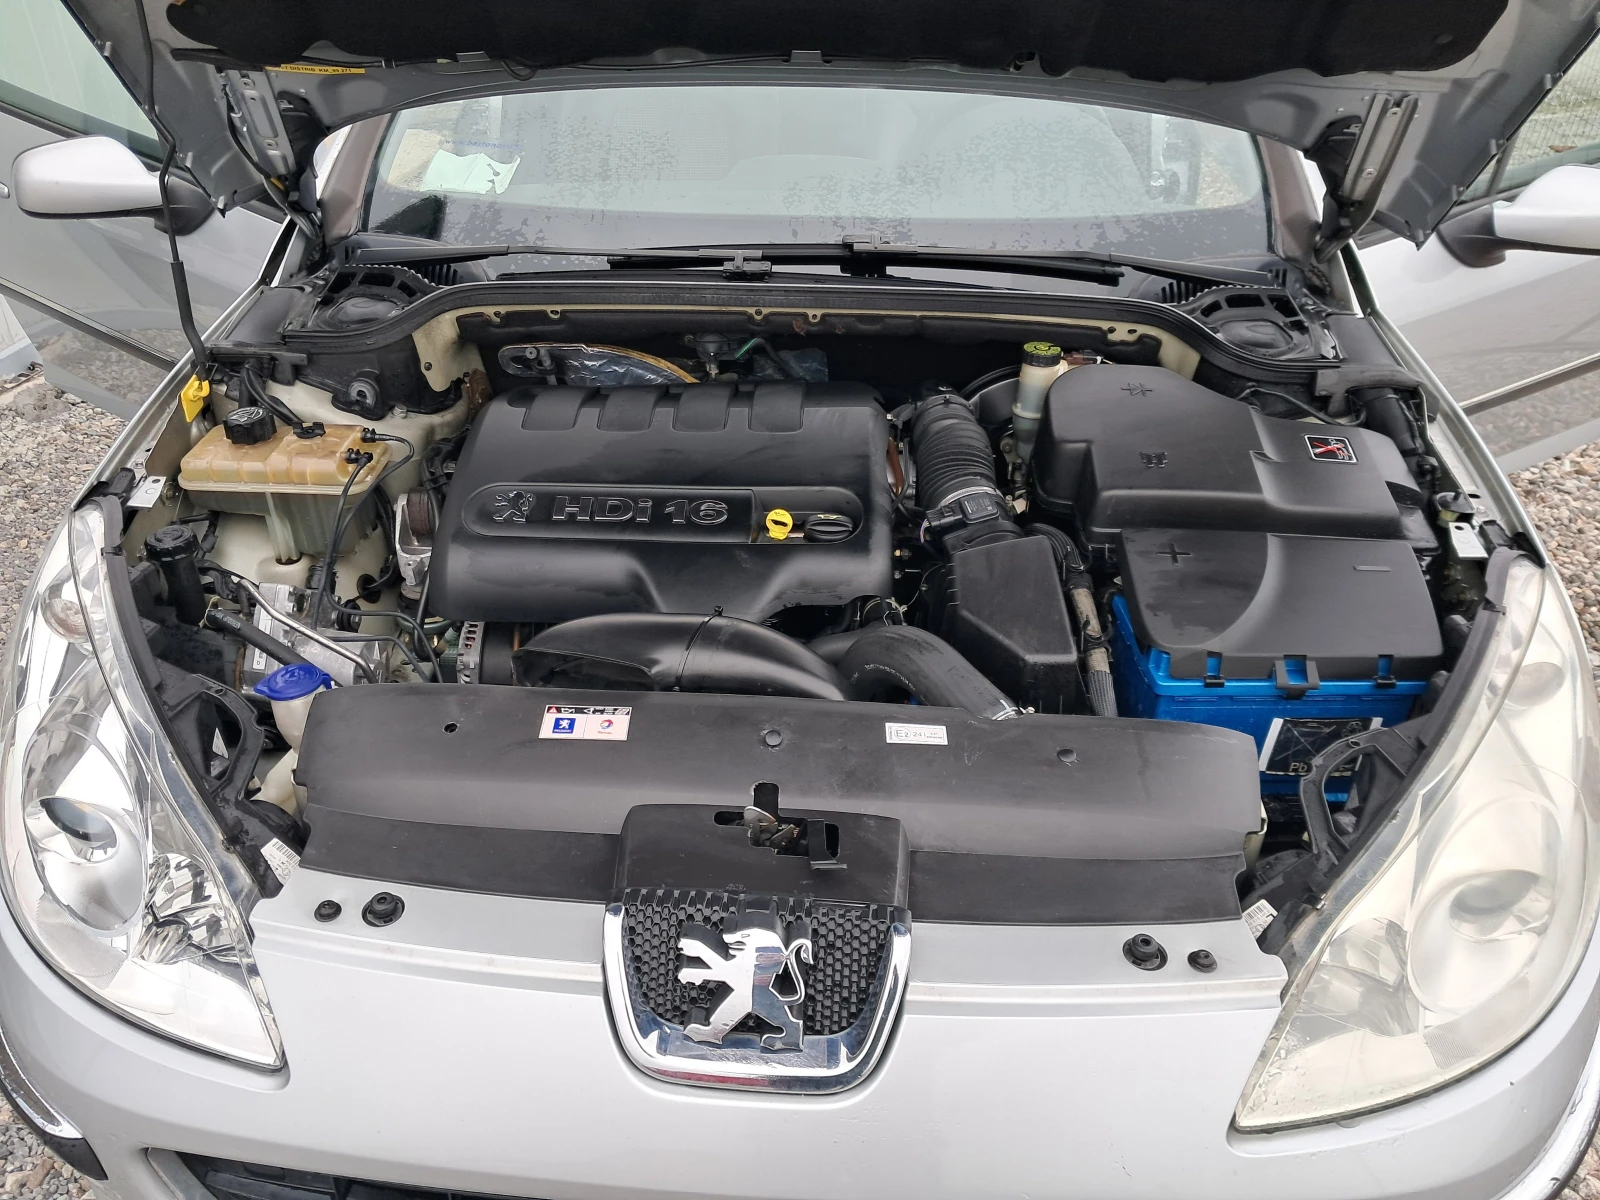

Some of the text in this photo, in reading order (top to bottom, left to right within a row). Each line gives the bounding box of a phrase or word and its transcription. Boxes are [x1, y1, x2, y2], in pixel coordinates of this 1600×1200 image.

[552, 496, 729, 525] HDi 16
[1289, 762, 1308, 772] Pb
